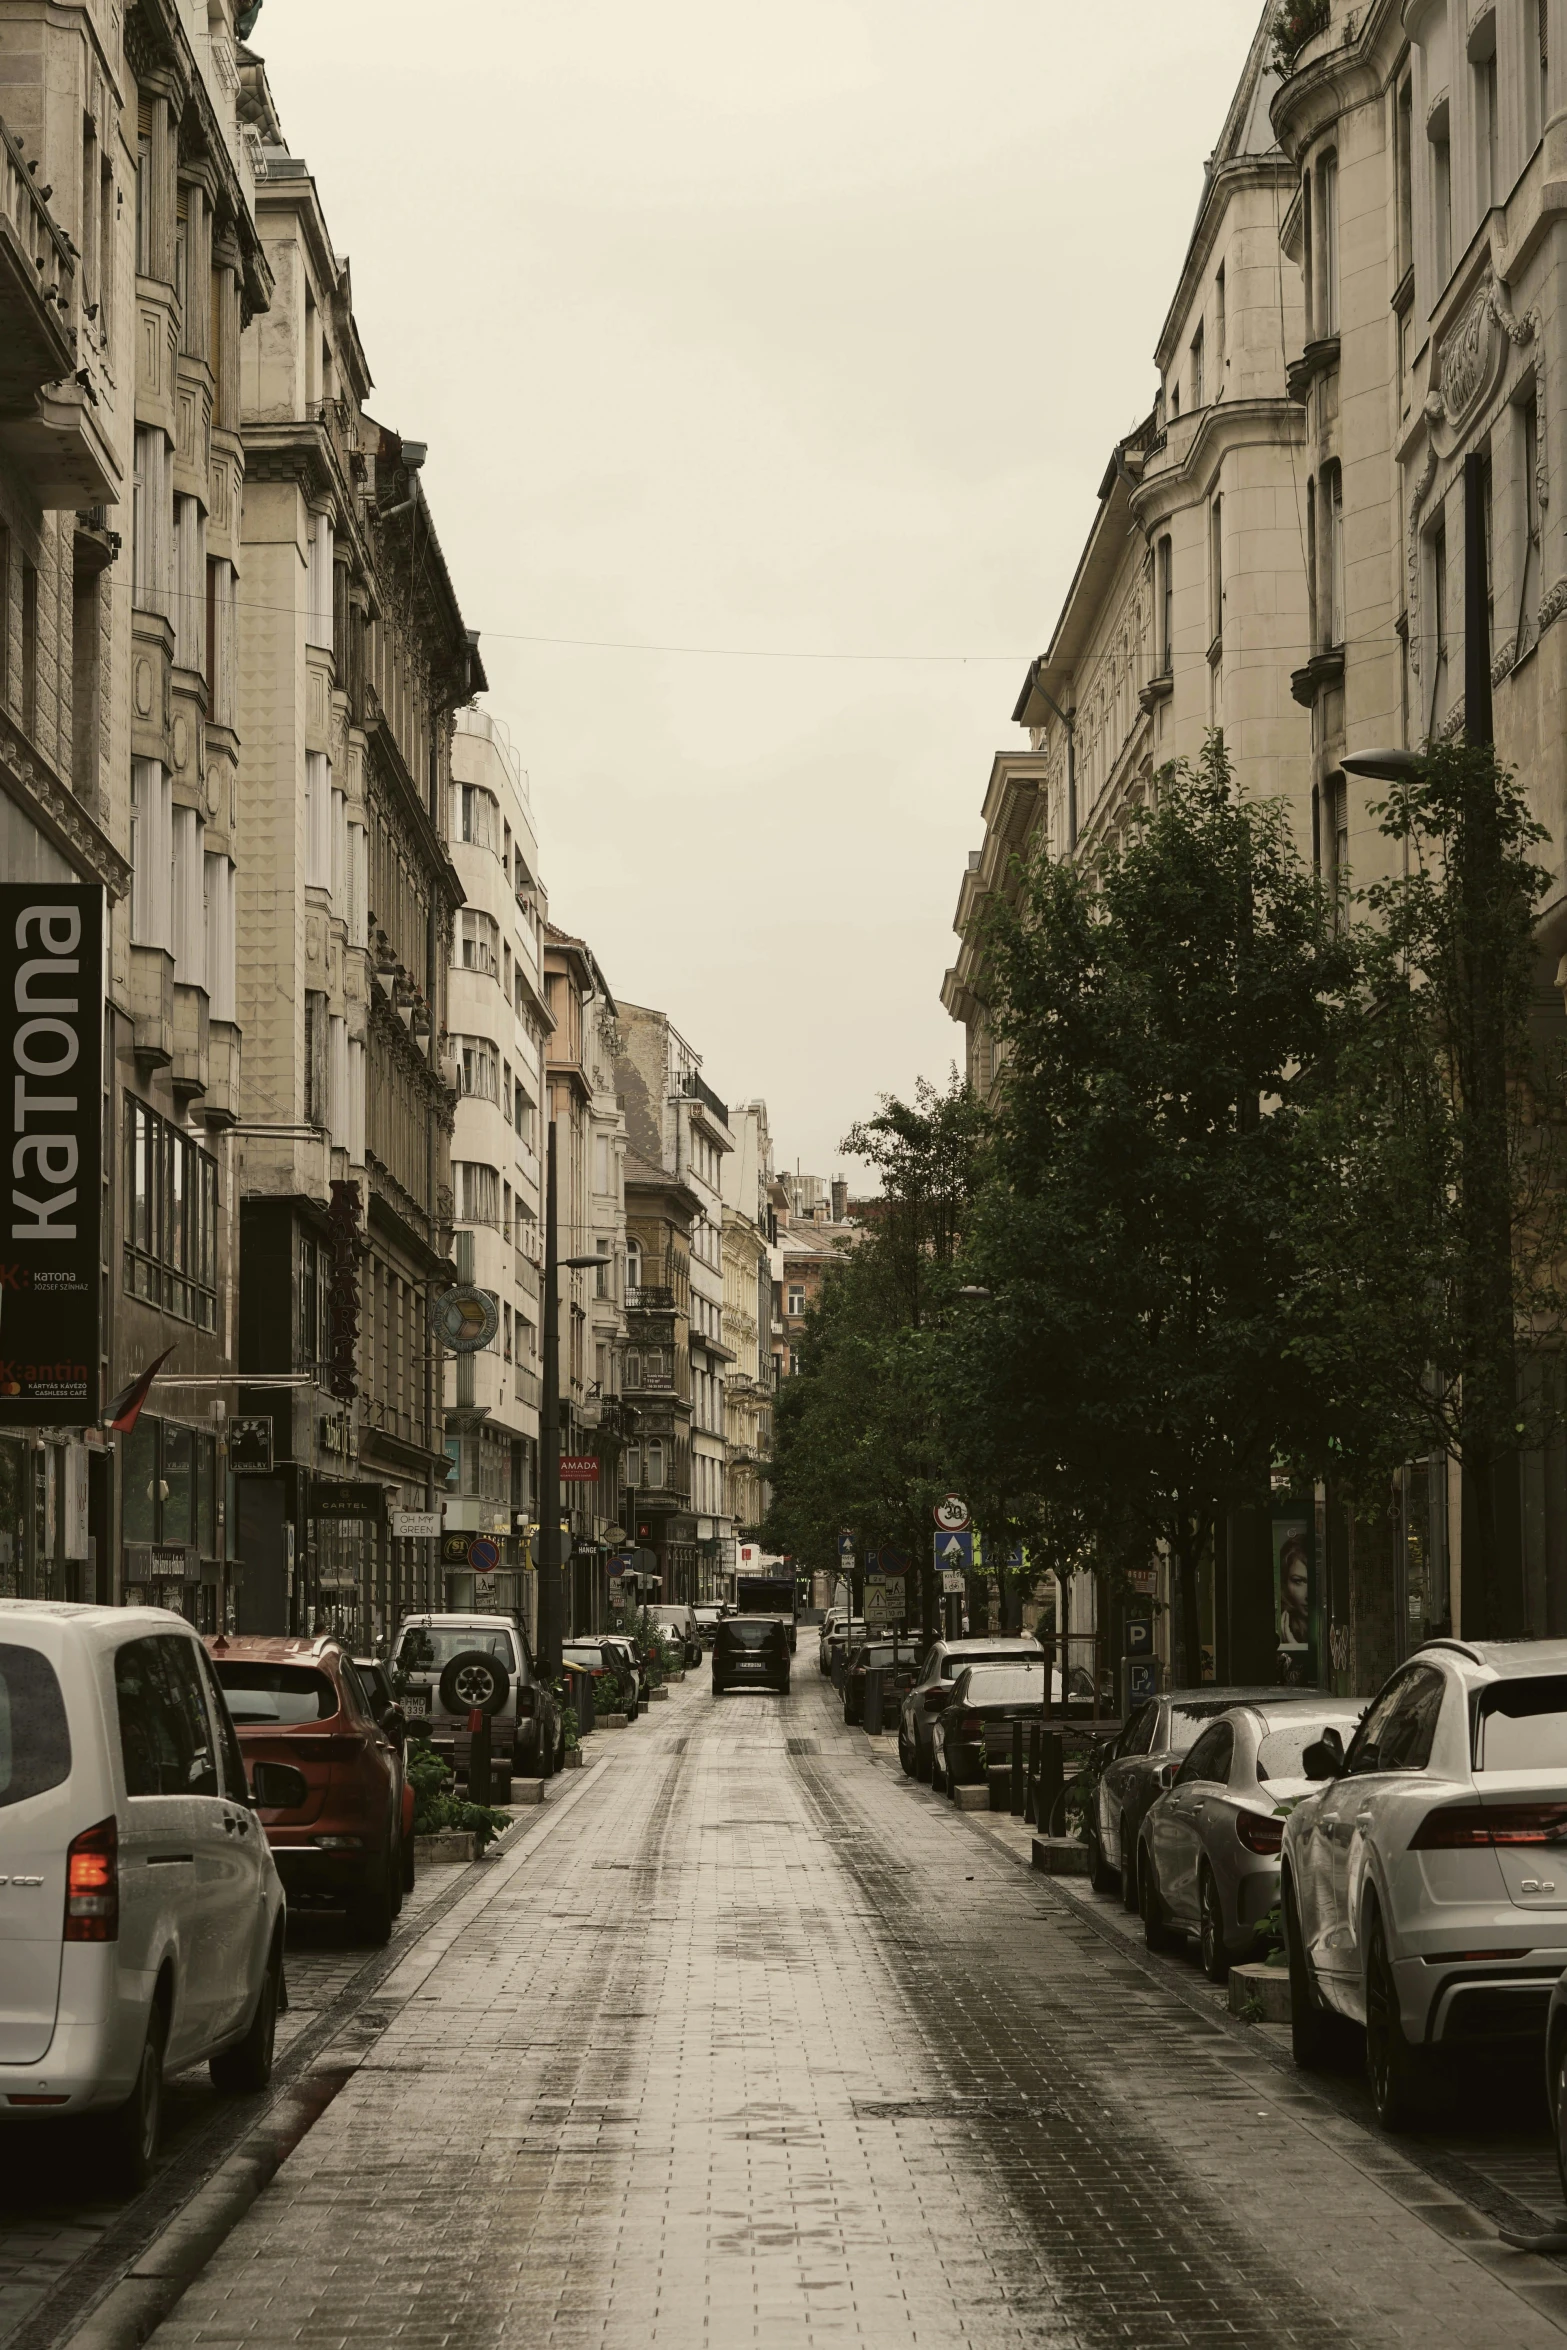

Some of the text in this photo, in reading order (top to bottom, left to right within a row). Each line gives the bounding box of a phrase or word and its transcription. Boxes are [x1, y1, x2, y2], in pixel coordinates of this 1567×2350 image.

[33, 1283, 89, 1291] JÓZSEF SZÍNHÁZ
[944, 1505, 963, 1520] 30
[400, 1515, 434, 1524] OH MY
[400, 1525, 434, 1534] GREEN
[868, 1552, 876, 1564] P
[616, 1619, 623, 1627] P
[1130, 1625, 1146, 1646] P
[405, 1697, 425, 1706] HMD
[407, 1706, 424, 1715] 339
[12, 1875, 45, 1886] CDI
[1521, 1880, 1555, 1893] Q8
